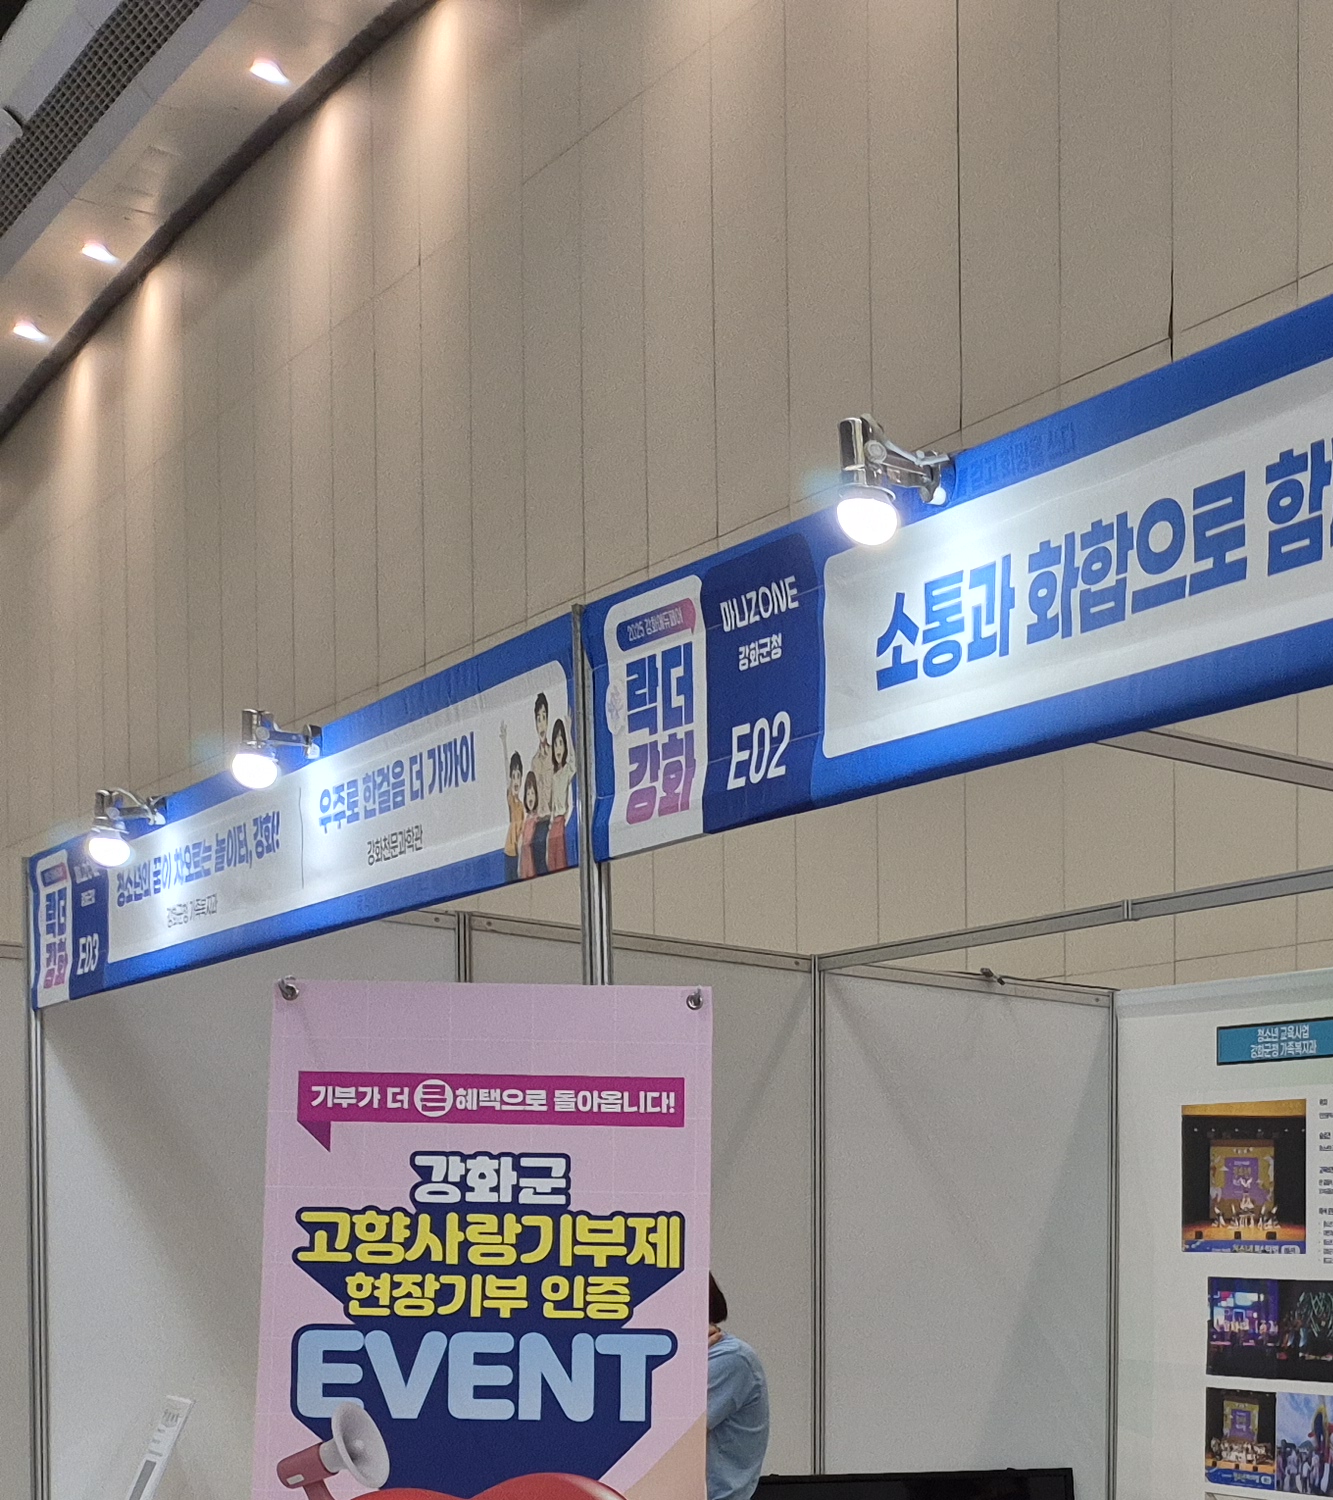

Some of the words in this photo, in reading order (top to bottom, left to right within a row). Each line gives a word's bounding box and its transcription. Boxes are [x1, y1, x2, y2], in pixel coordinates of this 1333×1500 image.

[876, 554, 1010, 691] 소통과
[1027, 471, 1246, 645] 화합으로
[739, 633, 782, 671] 강화군청
[727, 711, 791, 790] E02
[319, 783, 359, 834] 우주로
[363, 760, 406, 815] 한걸음
[410, 756, 424, 800] 더
[429, 732, 476, 792] 가까이
[367, 824, 424, 865] 강화천문과학관
[77, 933, 99, 975] E03
[311, 1085, 381, 1109] 기부가
[386, 1087, 410, 1109] 더
[415, 1080, 453, 1116] 큰
[455, 1088, 548, 1112] 혜택으로
[553, 1089, 675, 1114] 돌아옵니다!
[414, 1155, 568, 1205] 강화군
[298, 1211, 681, 1269] 고향사랑기부제
[345, 1272, 528, 1319] 현장기부
[541, 1275, 631, 1321] 인증
[297, 1330, 673, 1423] EVENT
